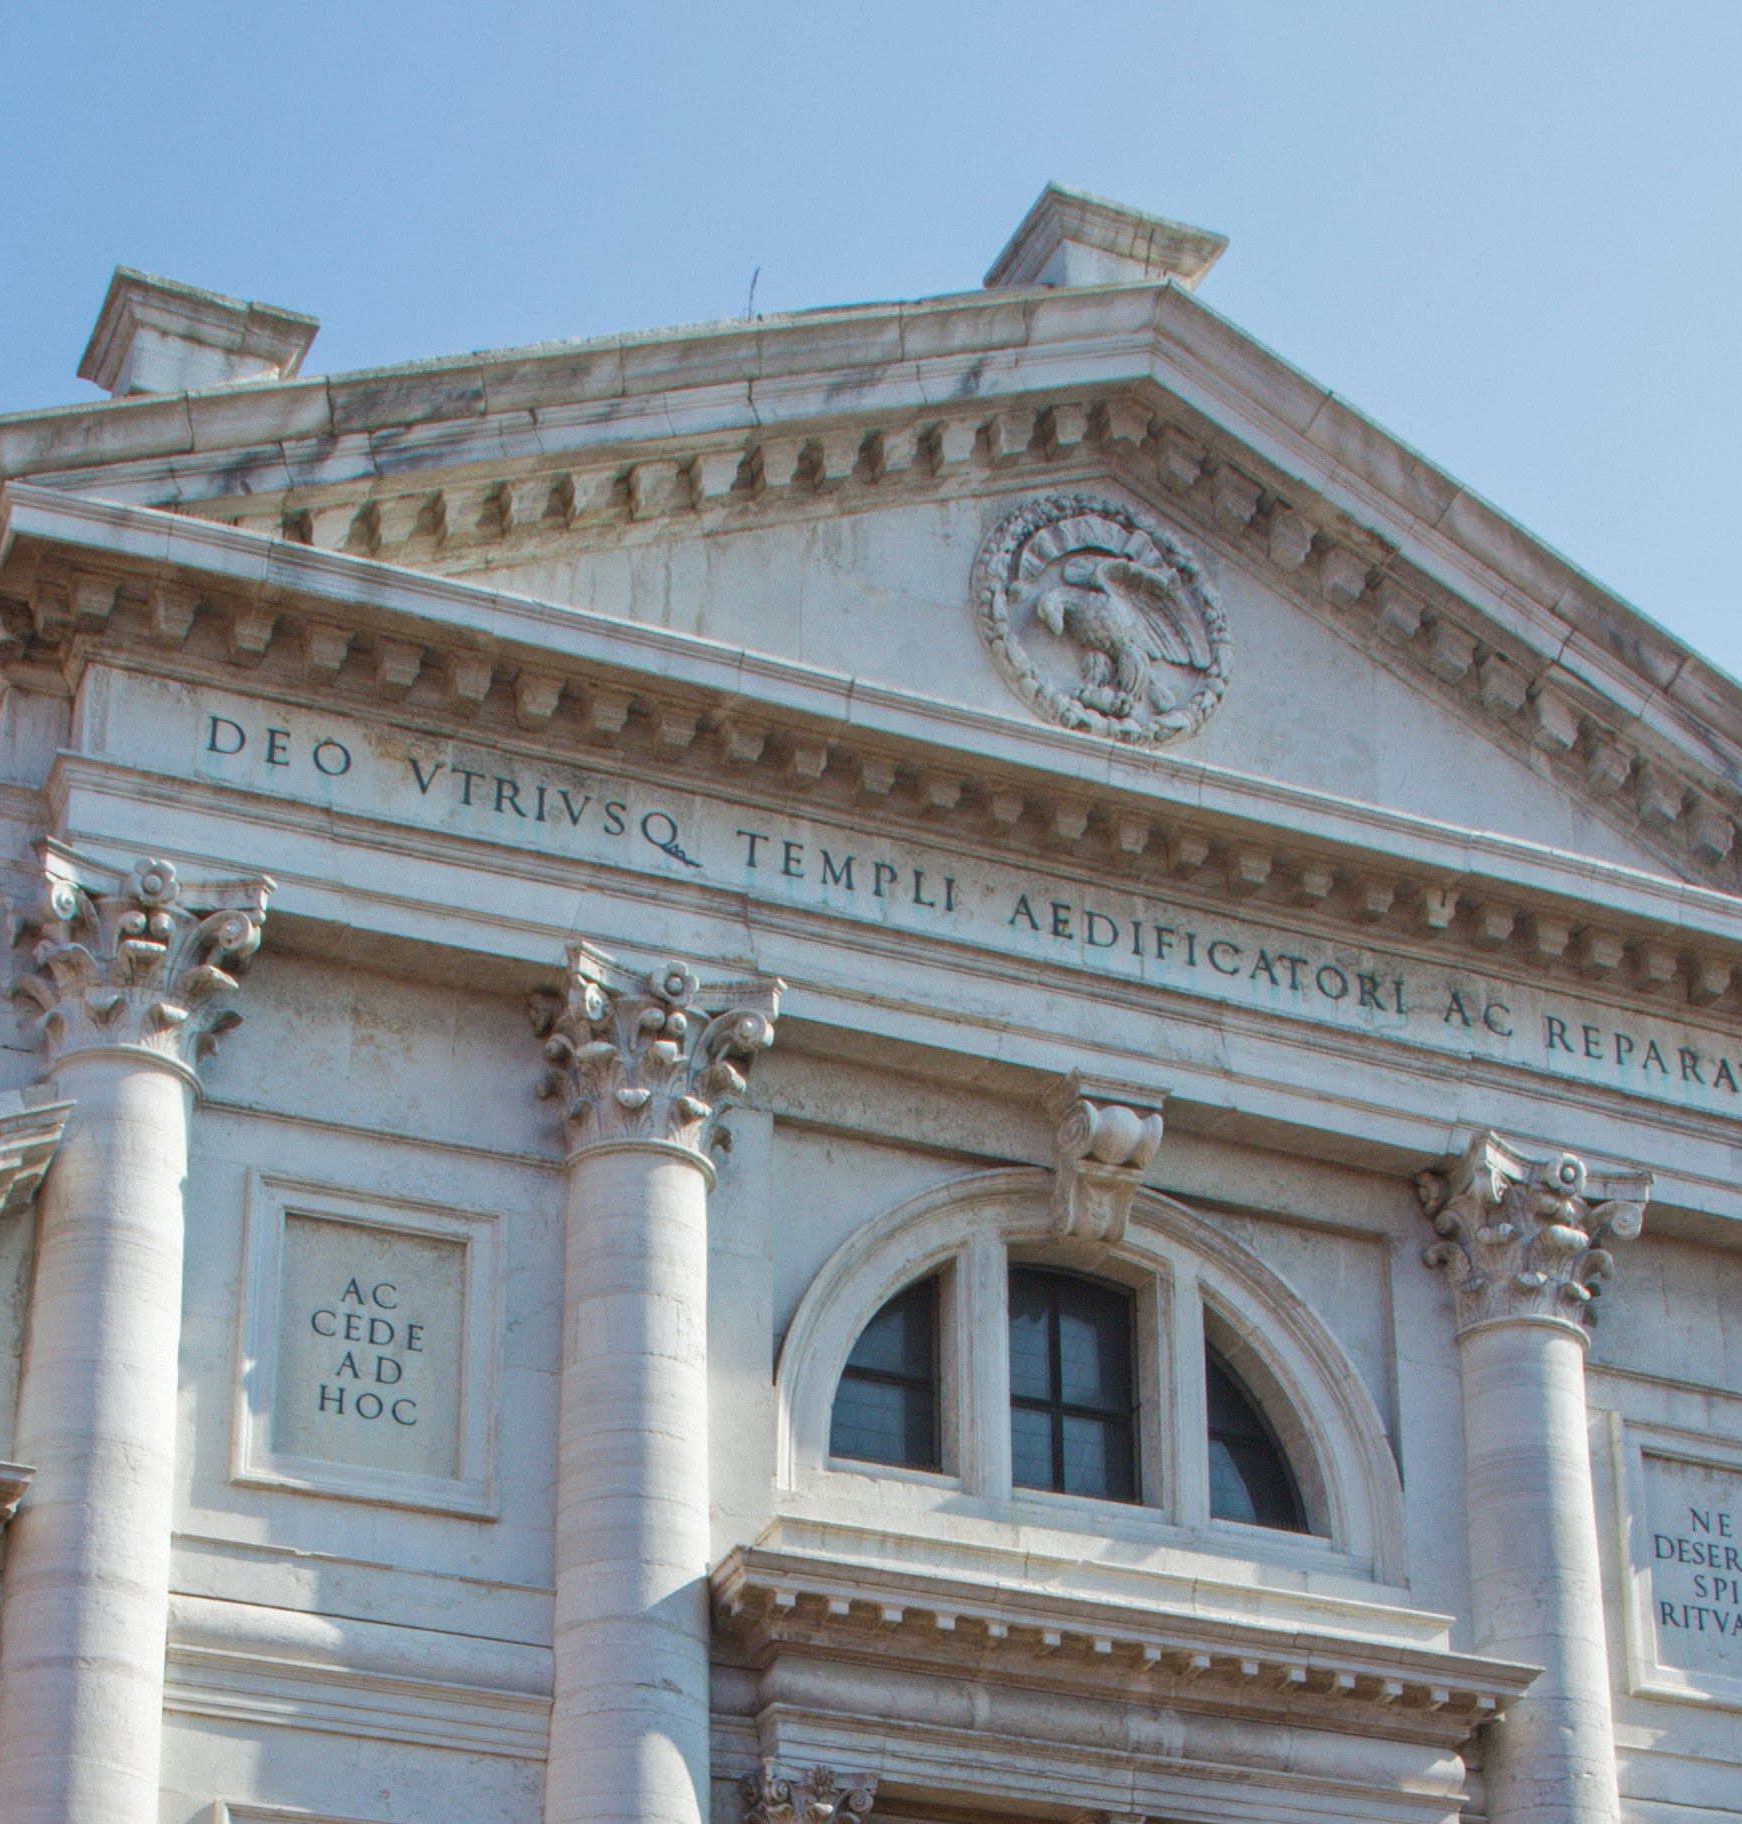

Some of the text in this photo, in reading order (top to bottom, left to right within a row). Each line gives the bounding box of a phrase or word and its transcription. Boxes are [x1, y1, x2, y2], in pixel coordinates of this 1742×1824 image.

[205, 714, 352, 776] DEO
[736, 829, 956, 912] TEMPLI
[1008, 893, 1407, 1015] AEDIFICATORI
[1443, 991, 1514, 1037] AC
[340, 1277, 398, 1309] AC
[311, 1310, 424, 1352] CEDE
[335, 1351, 402, 1385] AD
[318, 1384, 417, 1425] HOC
[1689, 1508, 1732, 1538] NE
[1694, 1574, 1739, 1604] SPI
